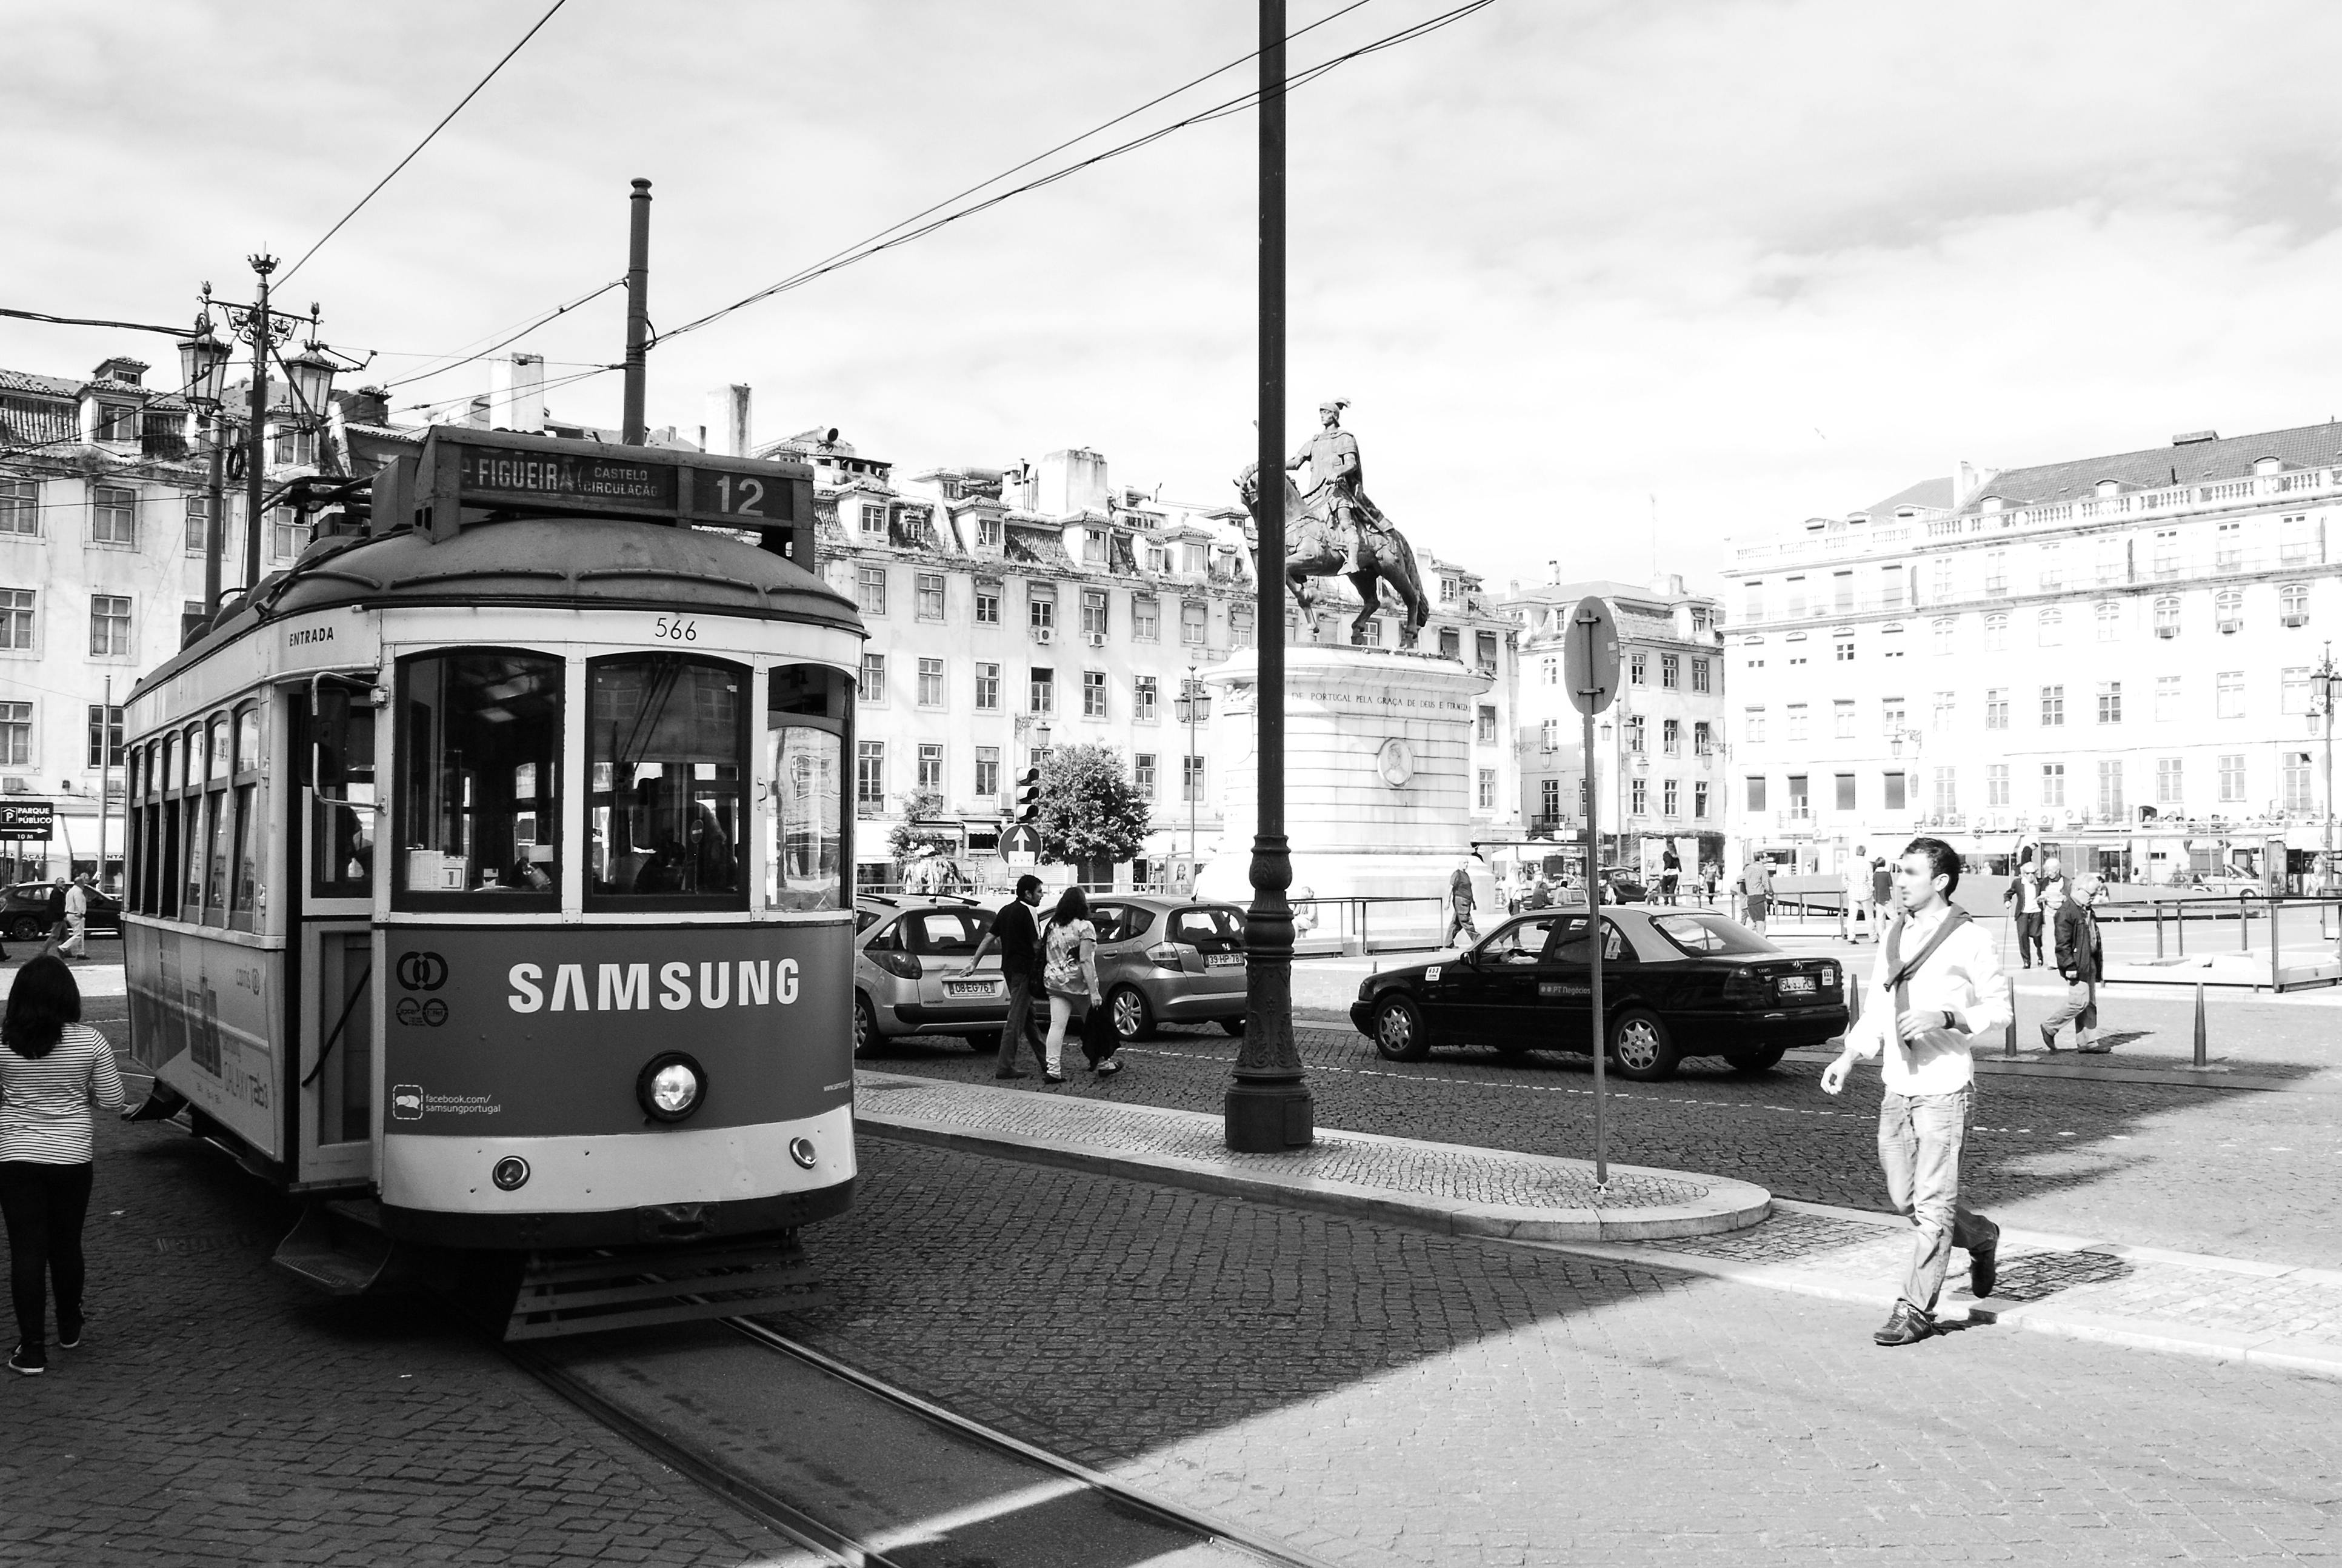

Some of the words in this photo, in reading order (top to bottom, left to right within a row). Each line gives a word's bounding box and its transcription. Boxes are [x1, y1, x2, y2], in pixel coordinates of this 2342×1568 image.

[479, 458, 574, 491] FIGUEIRA
[594, 467, 647, 481] CASTELO
[717, 475, 764, 517] 12
[289, 627, 334, 647] ENTRADA
[655, 618, 696, 641] 566
[1310, 692, 1352, 702] PORTUGAL
[1356, 695, 1373, 704] PELA
[1377, 696, 1403, 707] GRAÇA
[1407, 699, 1416, 707] DE
[1420, 700, 1435, 709] DEUS
[18, 815, 52, 824] PÚBLICO
[508, 958, 799, 1013] SAMSUNG
[425, 1093, 492, 1103] facebook.com/
[425, 1104, 501, 1115] samsungportugal
